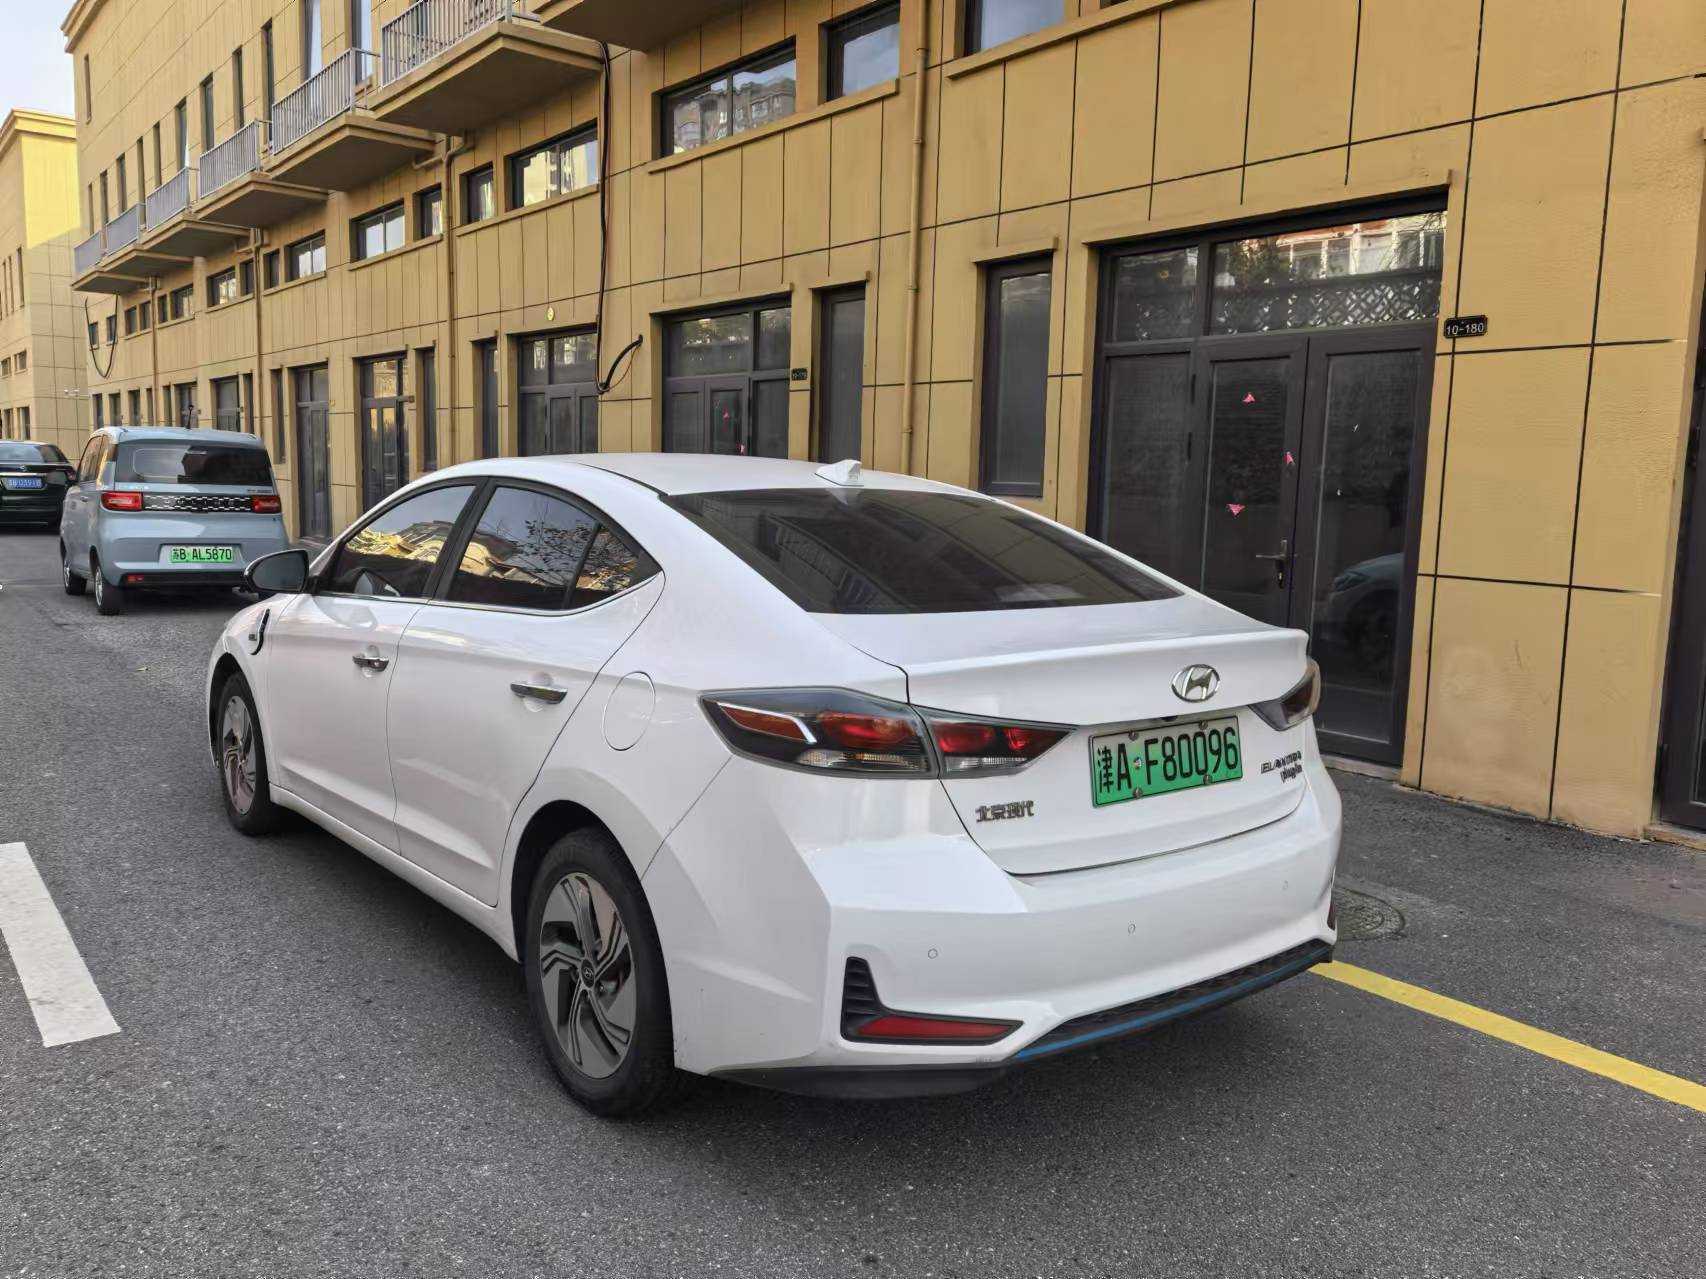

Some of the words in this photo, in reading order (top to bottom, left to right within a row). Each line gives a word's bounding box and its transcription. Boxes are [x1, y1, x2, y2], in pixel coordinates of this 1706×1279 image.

[1446, 322, 1484, 335] 10-180
[975, 800, 1035, 823] 北京现代
